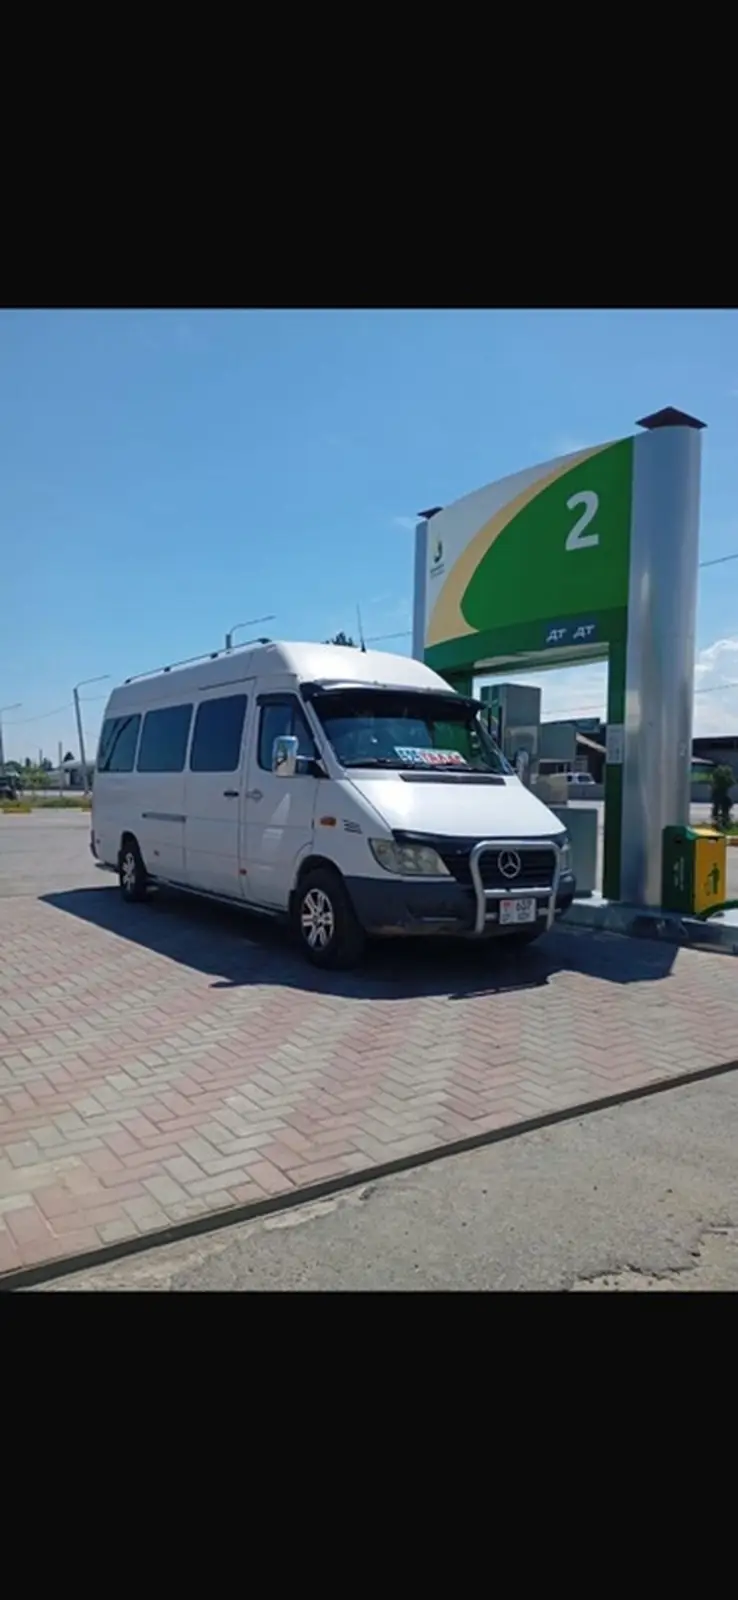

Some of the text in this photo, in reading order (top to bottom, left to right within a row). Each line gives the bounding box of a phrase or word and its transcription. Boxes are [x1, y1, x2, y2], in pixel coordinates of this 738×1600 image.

[565, 490, 599, 551] 2
[546, 624, 595, 642] ДТ ДТ
